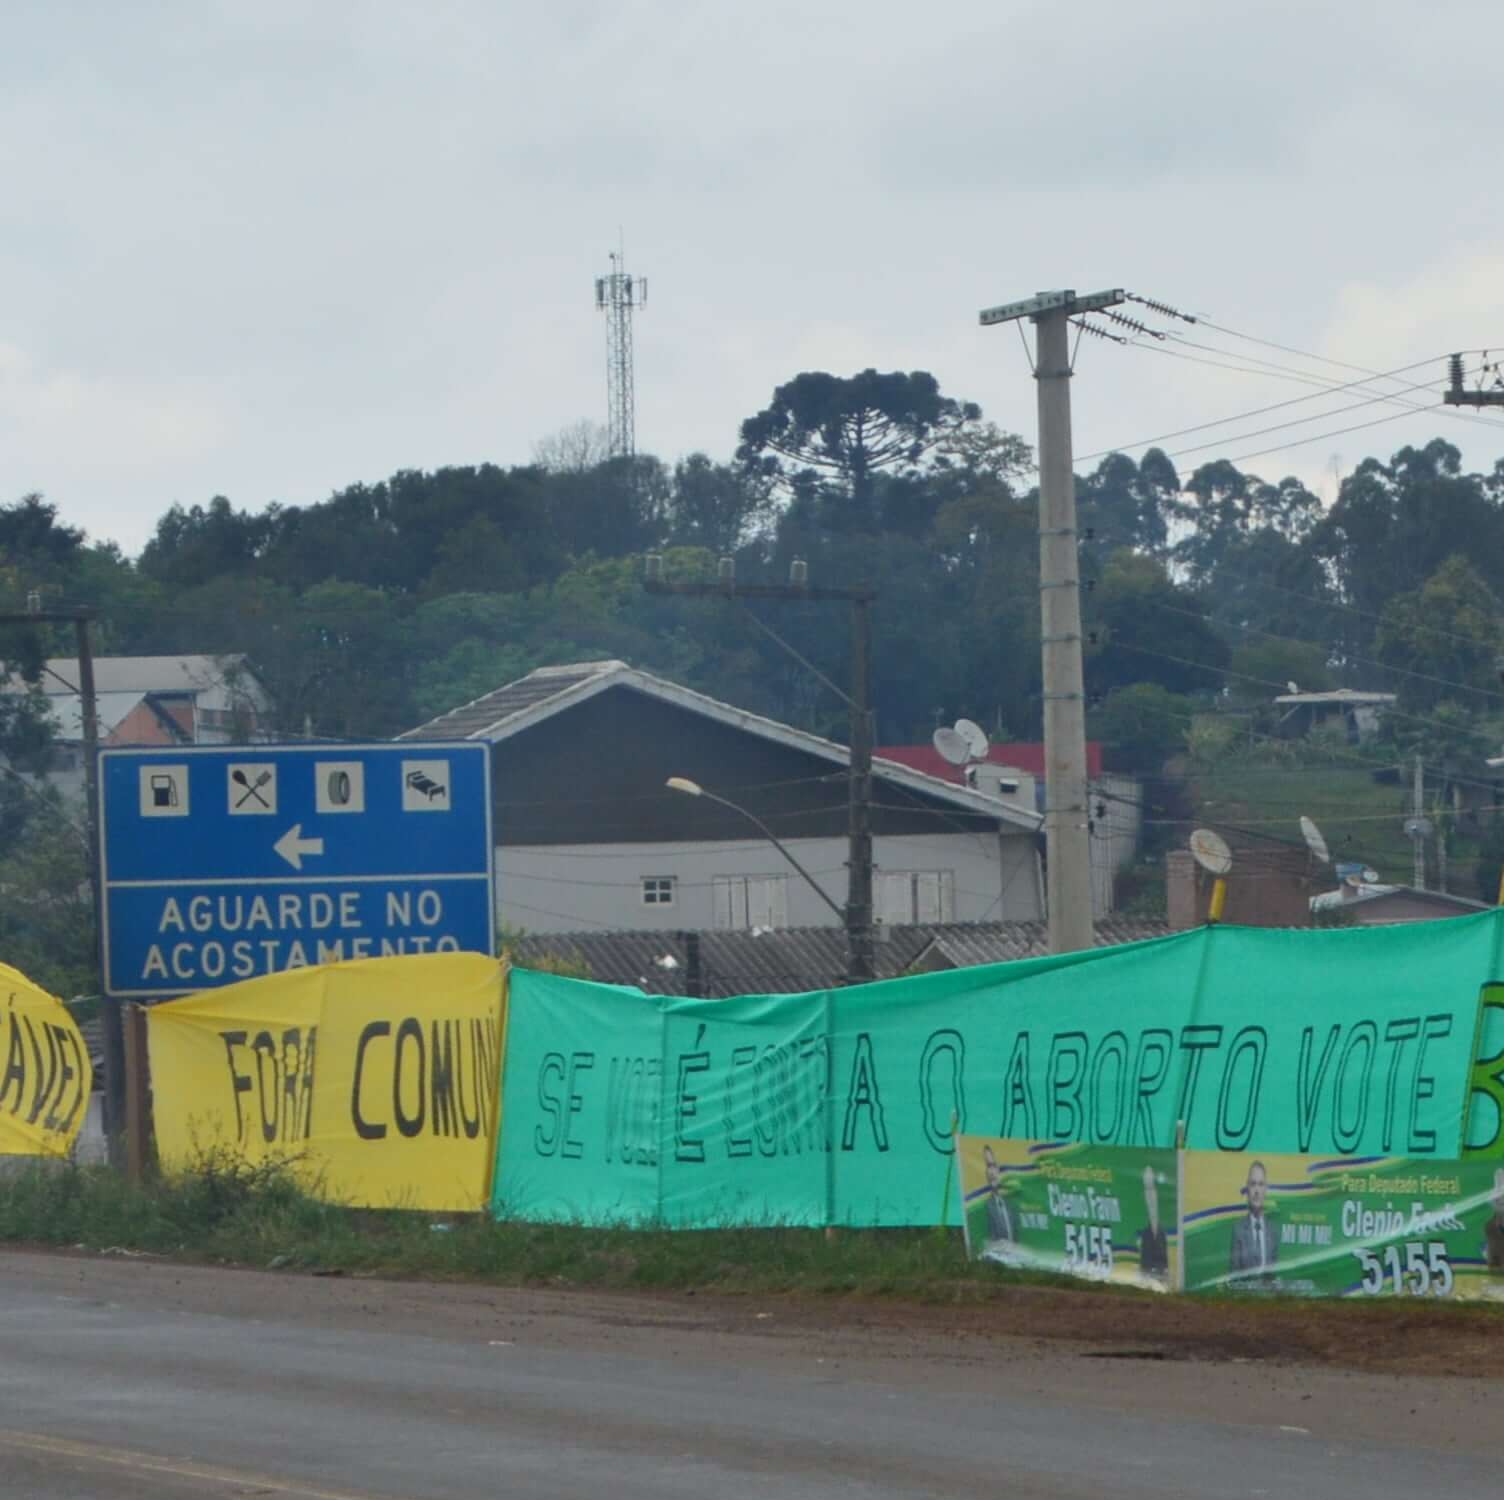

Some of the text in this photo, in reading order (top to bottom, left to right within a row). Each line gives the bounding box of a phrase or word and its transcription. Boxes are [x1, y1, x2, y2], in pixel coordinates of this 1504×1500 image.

[158, 889, 443, 933] AGUARDE NO
[218, 1025, 318, 1143] FORA
[533, 1051, 595, 1160] SE
[918, 1028, 966, 1155] O
[998, 1022, 1269, 1153] ABORTO
[1296, 1010, 1454, 1155] VOTE
[1341, 1174, 1460, 1197] Para Deputado Federal
[1342, 1200, 1403, 1238] Clenio
[1353, 1240, 1454, 1297] 5155
